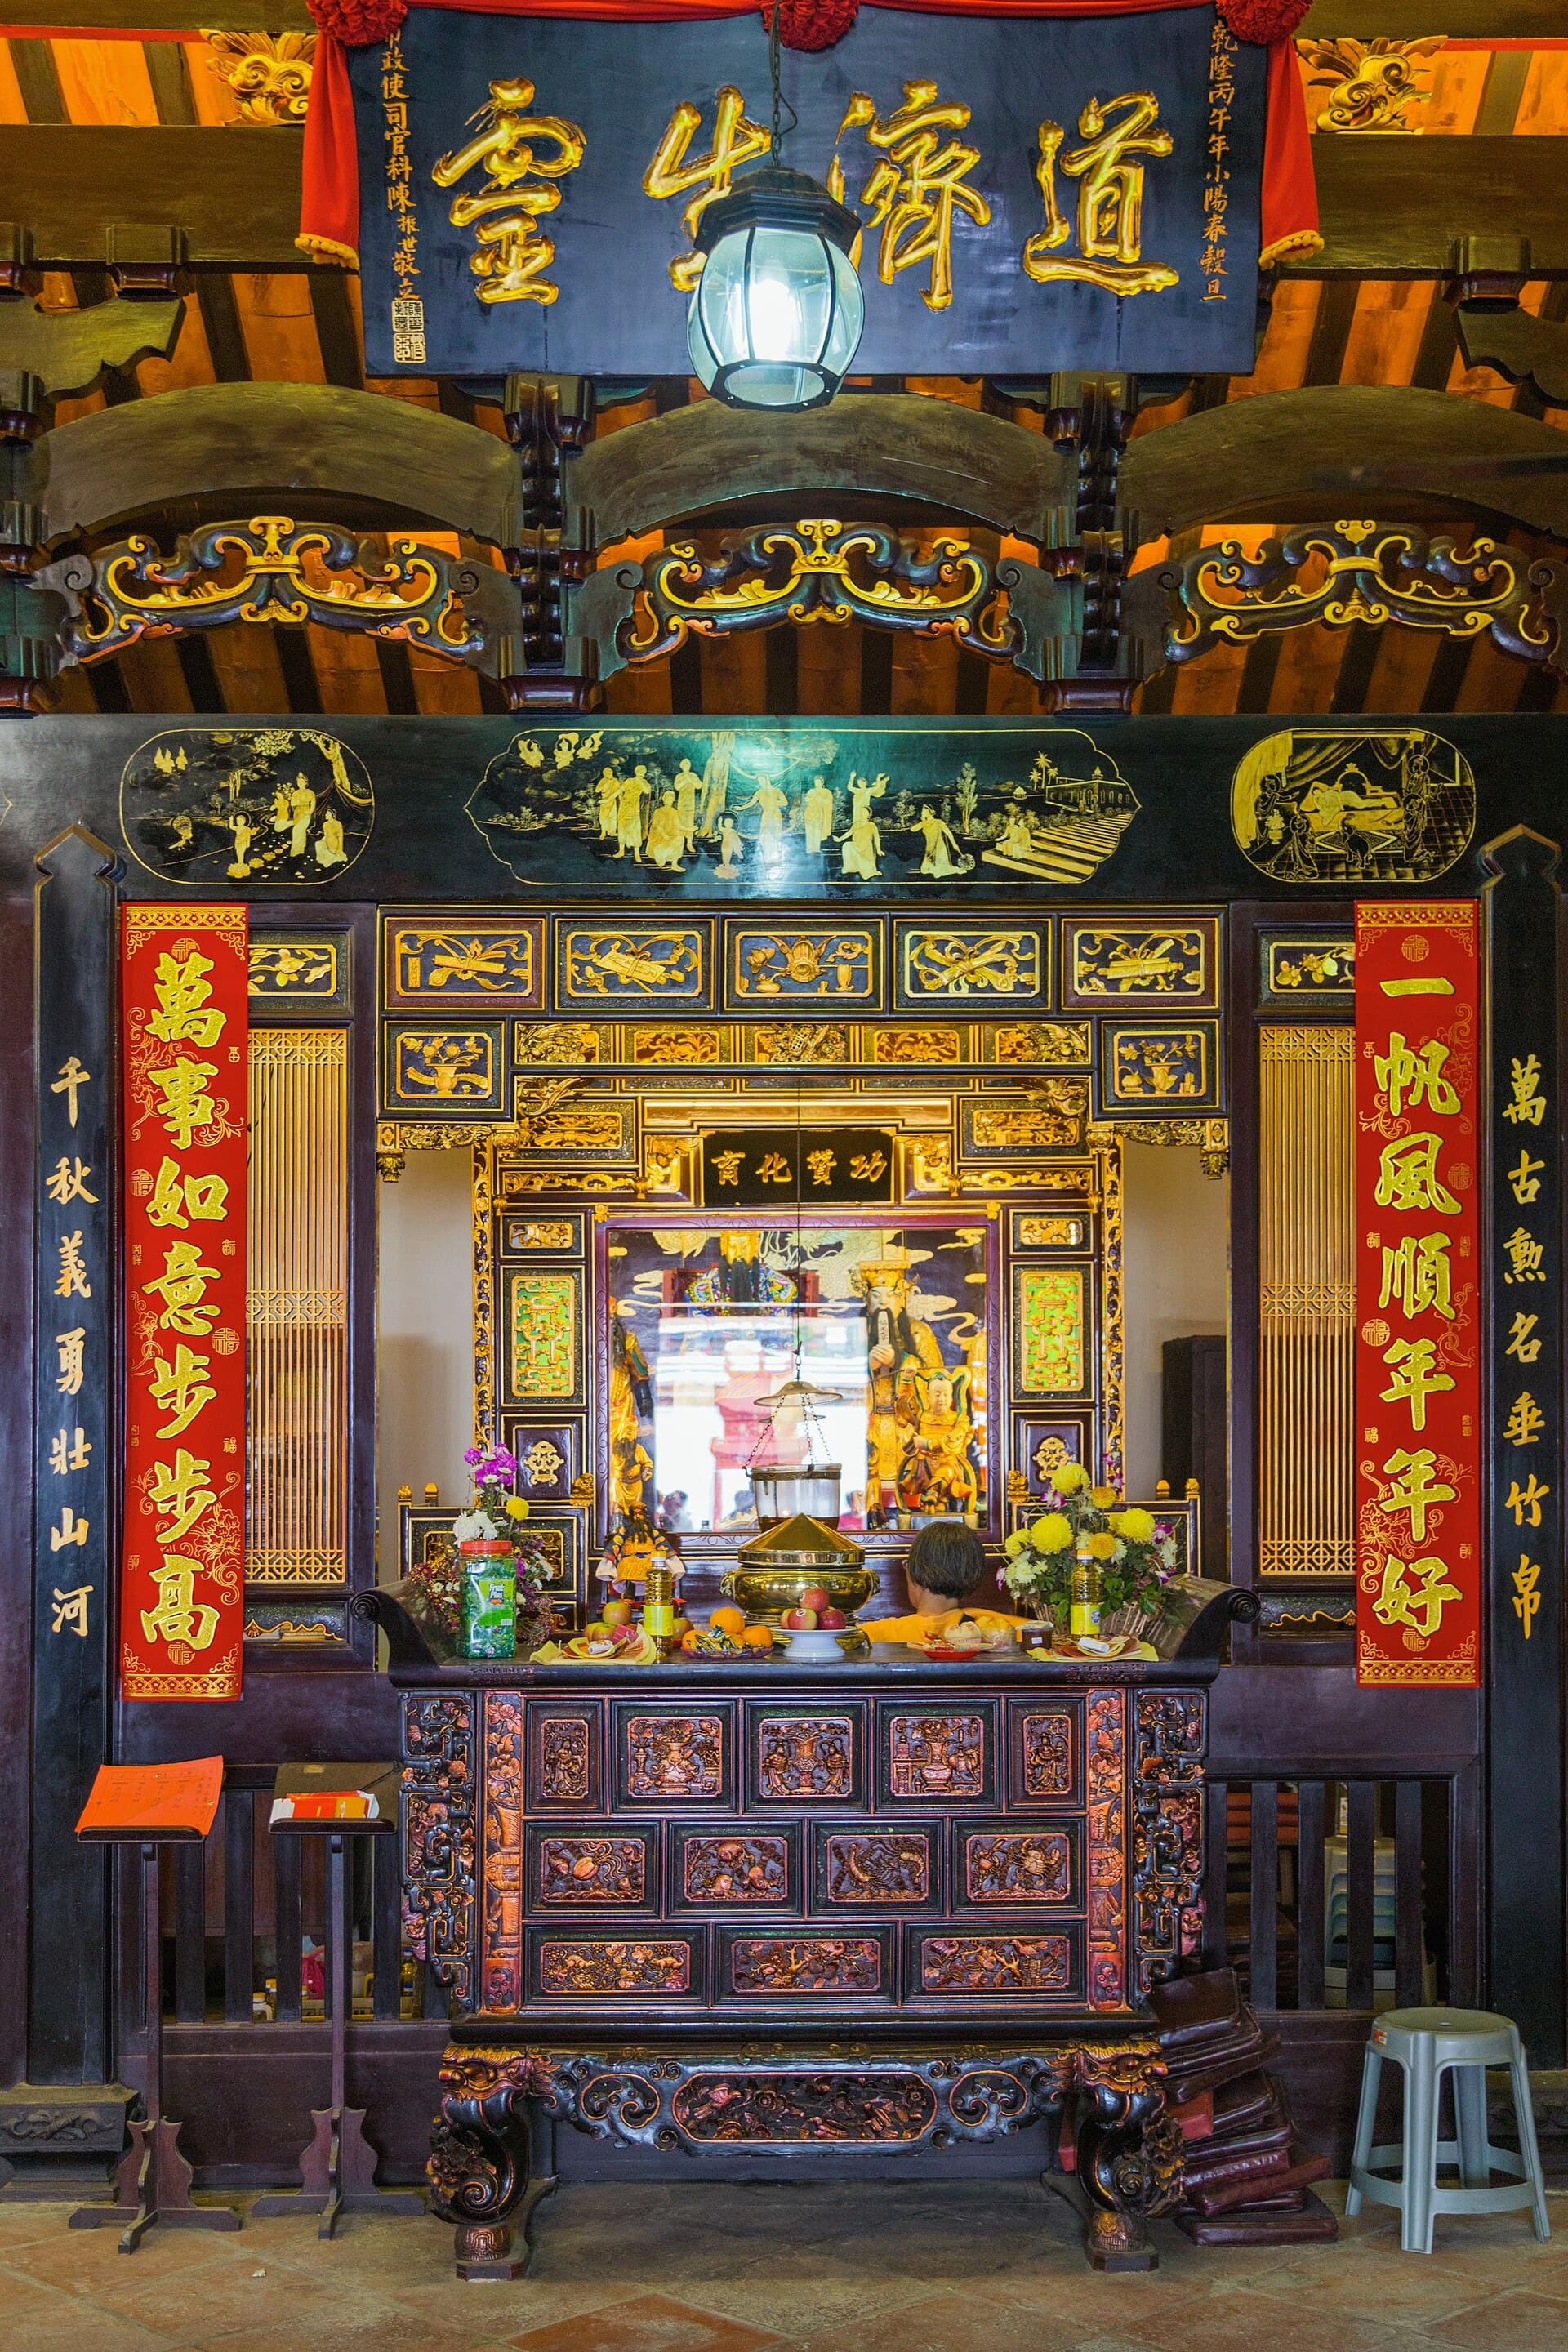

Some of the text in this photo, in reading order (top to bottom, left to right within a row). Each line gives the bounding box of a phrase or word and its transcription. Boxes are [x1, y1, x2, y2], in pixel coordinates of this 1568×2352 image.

[46, 1056, 100, 1637] 千秋義勇壯山河
[140, 951, 229, 1650] 萬事如意步步高
[1372, 977, 1463, 1637] 一帆風順年年好
